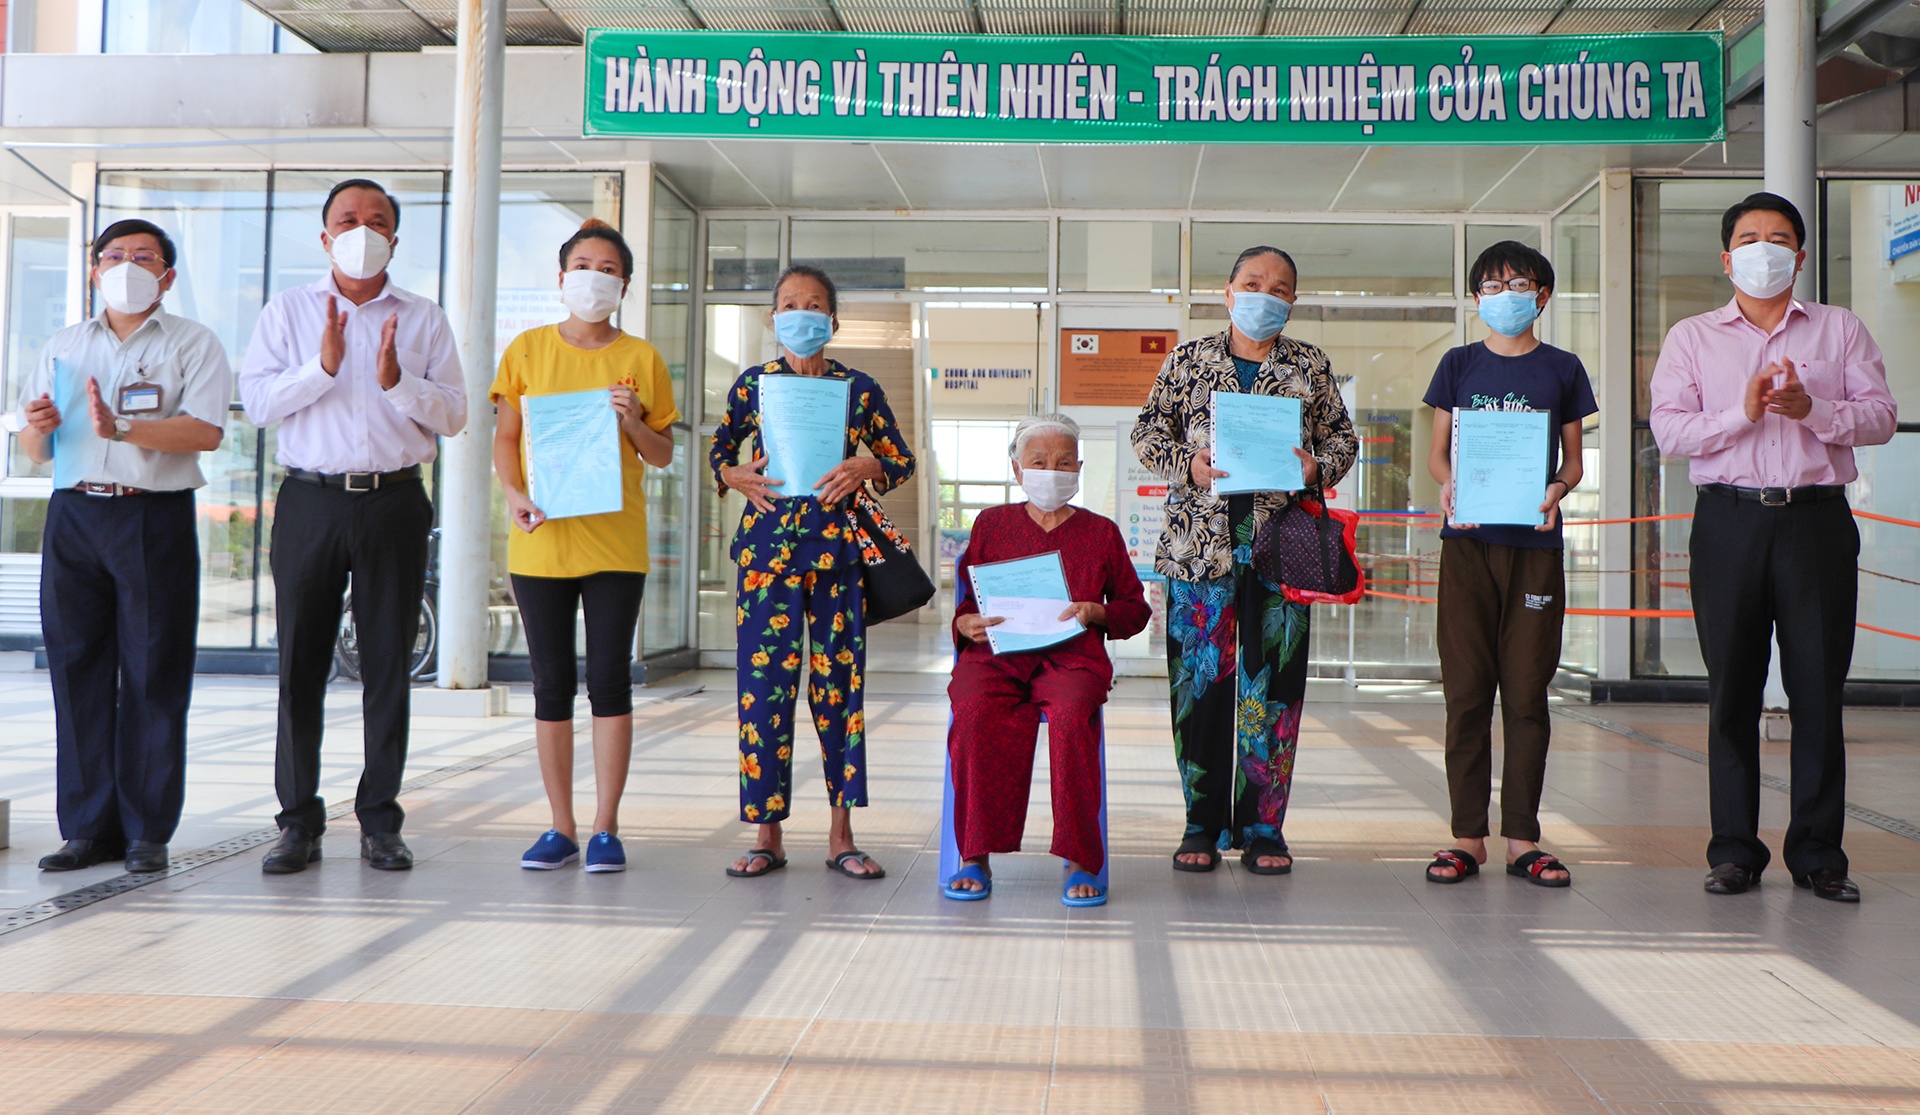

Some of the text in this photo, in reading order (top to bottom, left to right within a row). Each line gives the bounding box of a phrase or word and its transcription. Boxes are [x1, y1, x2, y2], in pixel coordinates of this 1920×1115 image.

[604, 46, 707, 113] HÀNH
[717, 47, 821, 129] ĐỘNG
[831, 48, 867, 118] VÌ
[878, 50, 988, 118] THIÊN
[999, 51, 1118, 120] NHIÊN
[1152, 52, 1278, 122] TRÁCH
[1289, 52, 1416, 135] NHIỆM
[1427, 44, 1508, 122] CỦA
[1517, 50, 1651, 121] CHÚNG
[1661, 60, 1706, 119] TA
[988, 369, 1032, 378] UNIVERSITY
[945, 380, 978, 389] HOSPITAL
